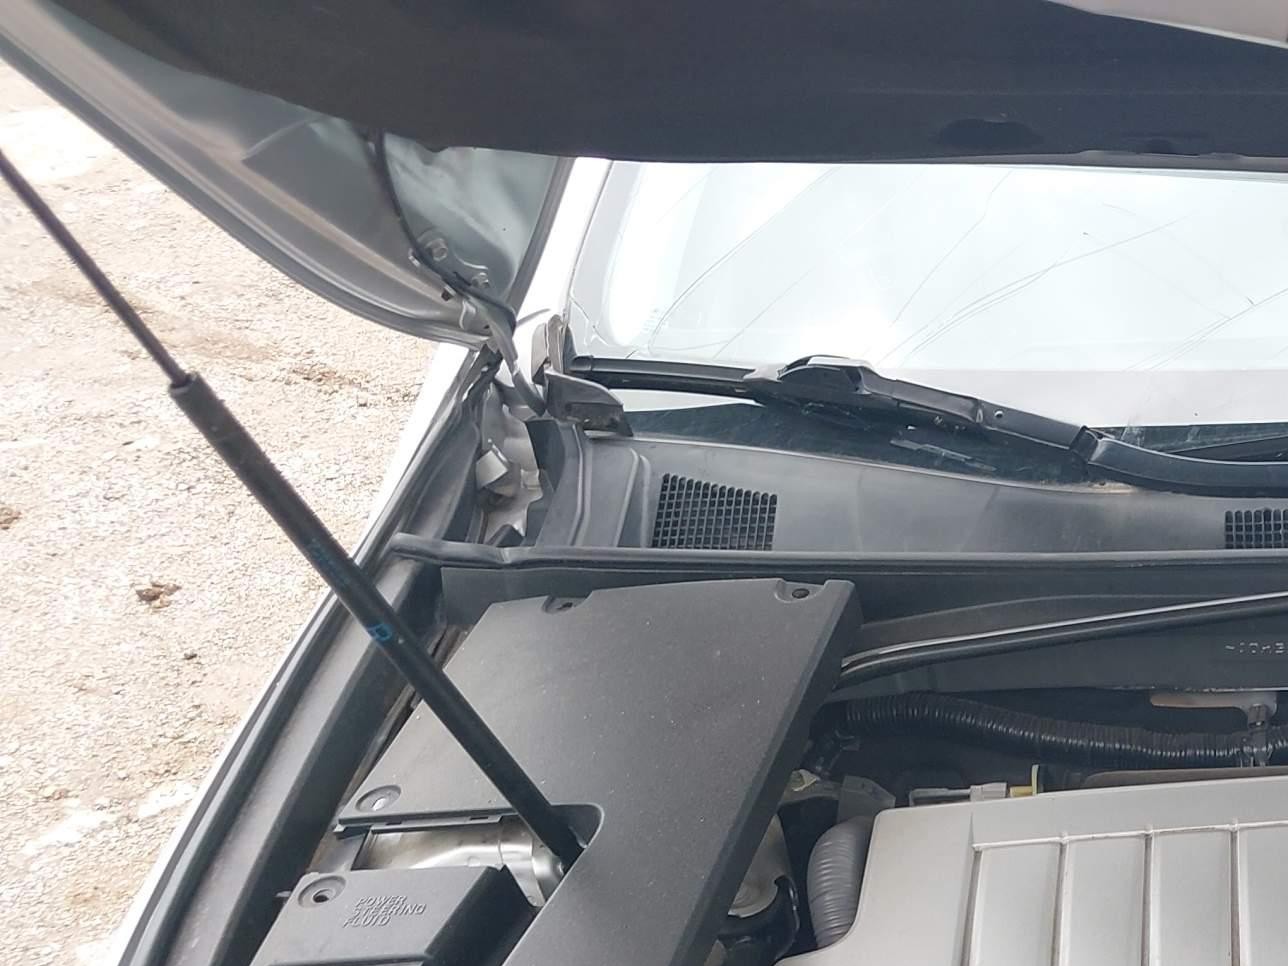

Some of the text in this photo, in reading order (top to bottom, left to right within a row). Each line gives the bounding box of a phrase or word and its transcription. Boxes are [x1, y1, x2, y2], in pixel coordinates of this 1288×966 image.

[356, 895, 408, 907] POWER
[352, 903, 427, 917] STEERING
[343, 914, 391, 928] FLUID
